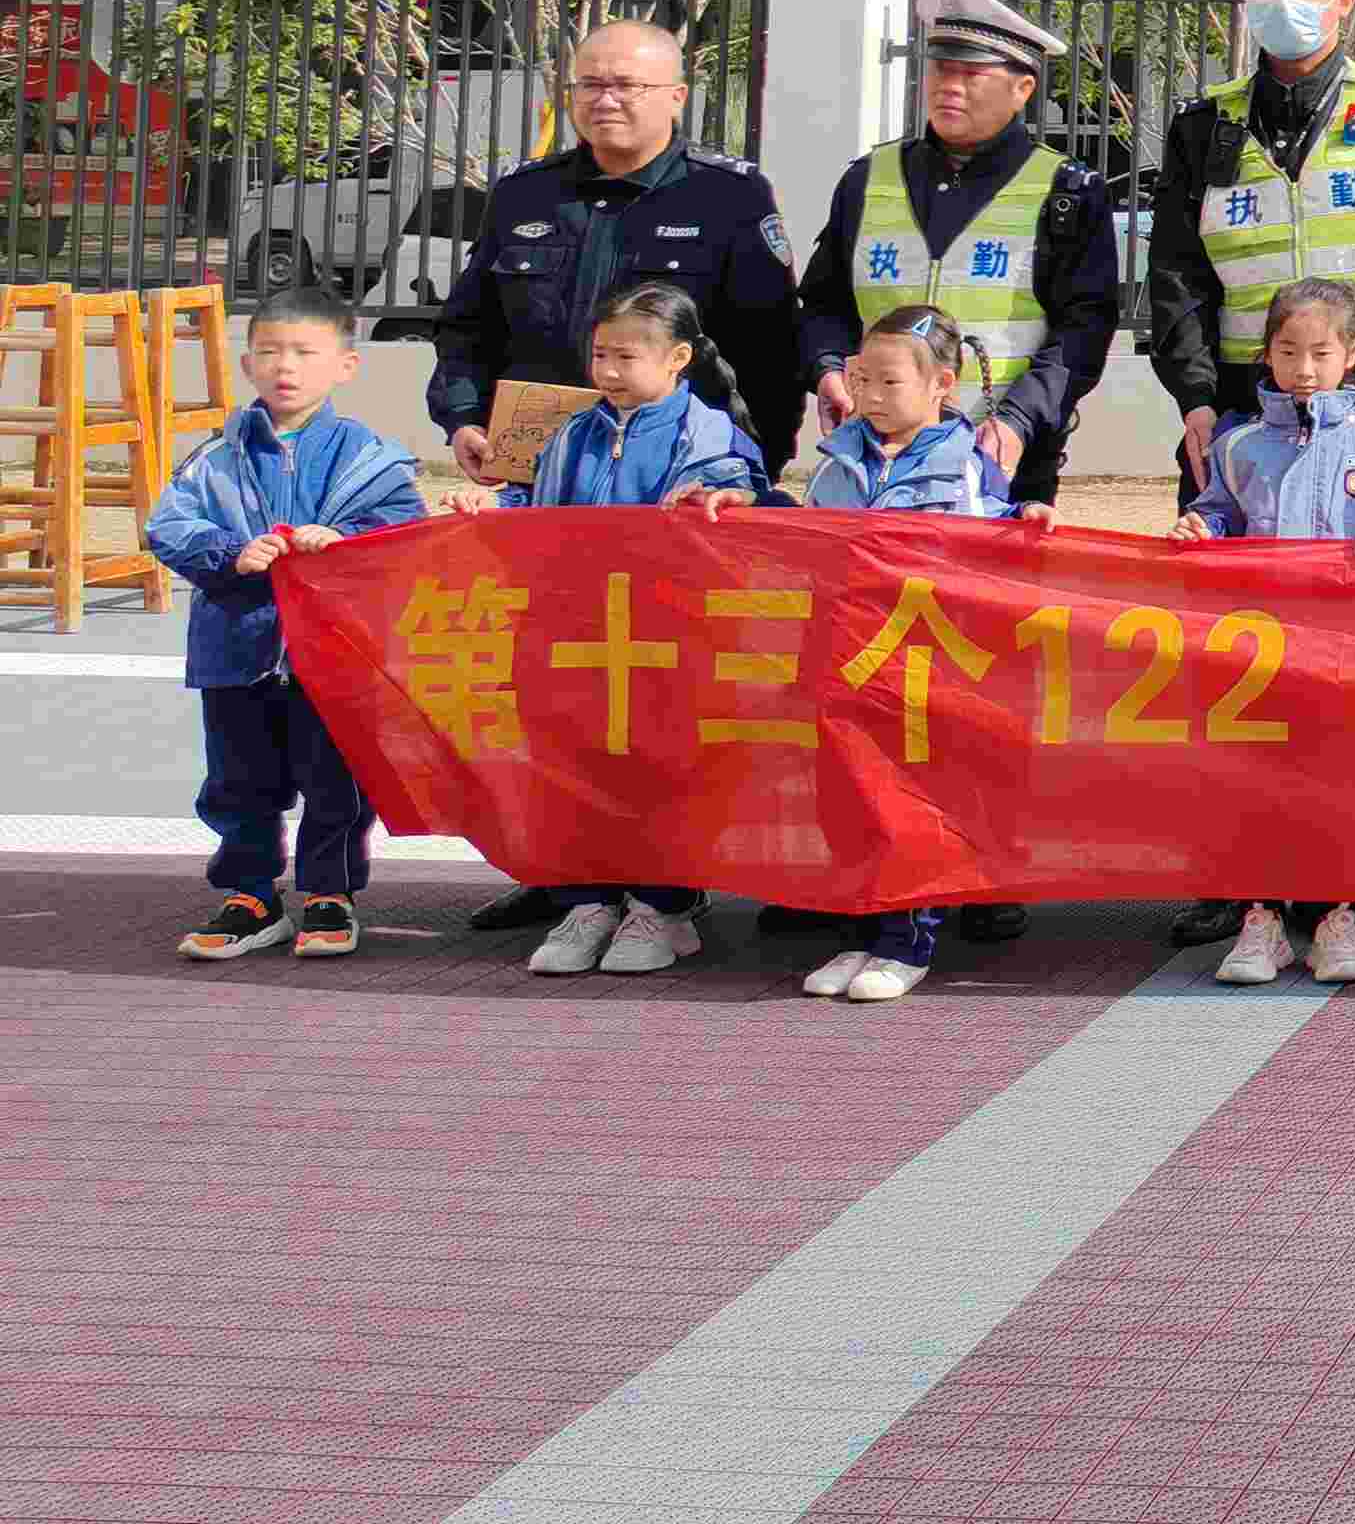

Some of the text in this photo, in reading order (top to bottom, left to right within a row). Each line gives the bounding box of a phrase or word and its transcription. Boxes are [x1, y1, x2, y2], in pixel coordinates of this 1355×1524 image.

[1226, 190, 1262, 226] 执
[869, 241, 1009, 281] 执 勤
